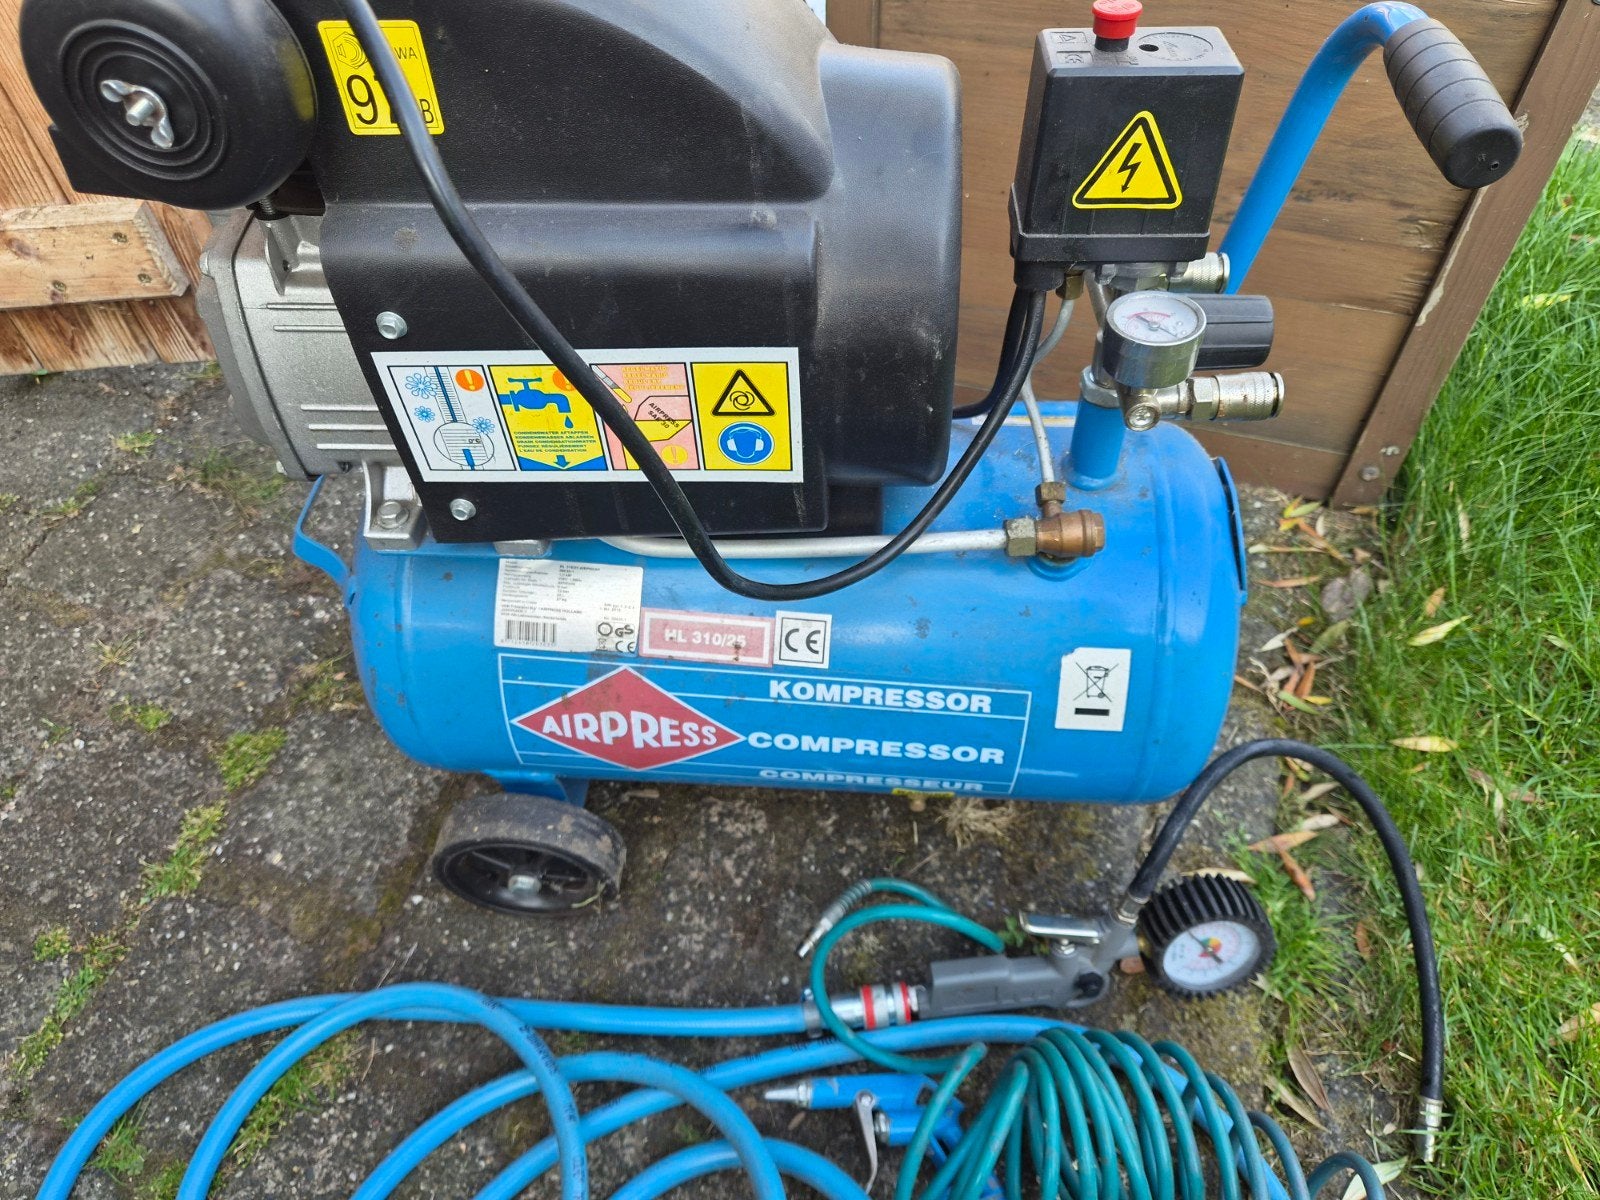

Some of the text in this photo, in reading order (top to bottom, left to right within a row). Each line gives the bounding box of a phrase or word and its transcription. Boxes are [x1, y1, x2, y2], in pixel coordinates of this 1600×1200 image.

[346, 73, 397, 126] 9
[649, 402, 680, 429] AIRPRESS
[664, 628, 747, 649] HL 310/25
[769, 679, 992, 713] KOMPRESSOR
[542, 710, 718, 749] AIRPRESS
[747, 731, 1005, 765] COMPRESSOR
[759, 769, 984, 791] COMPRESSEUR
